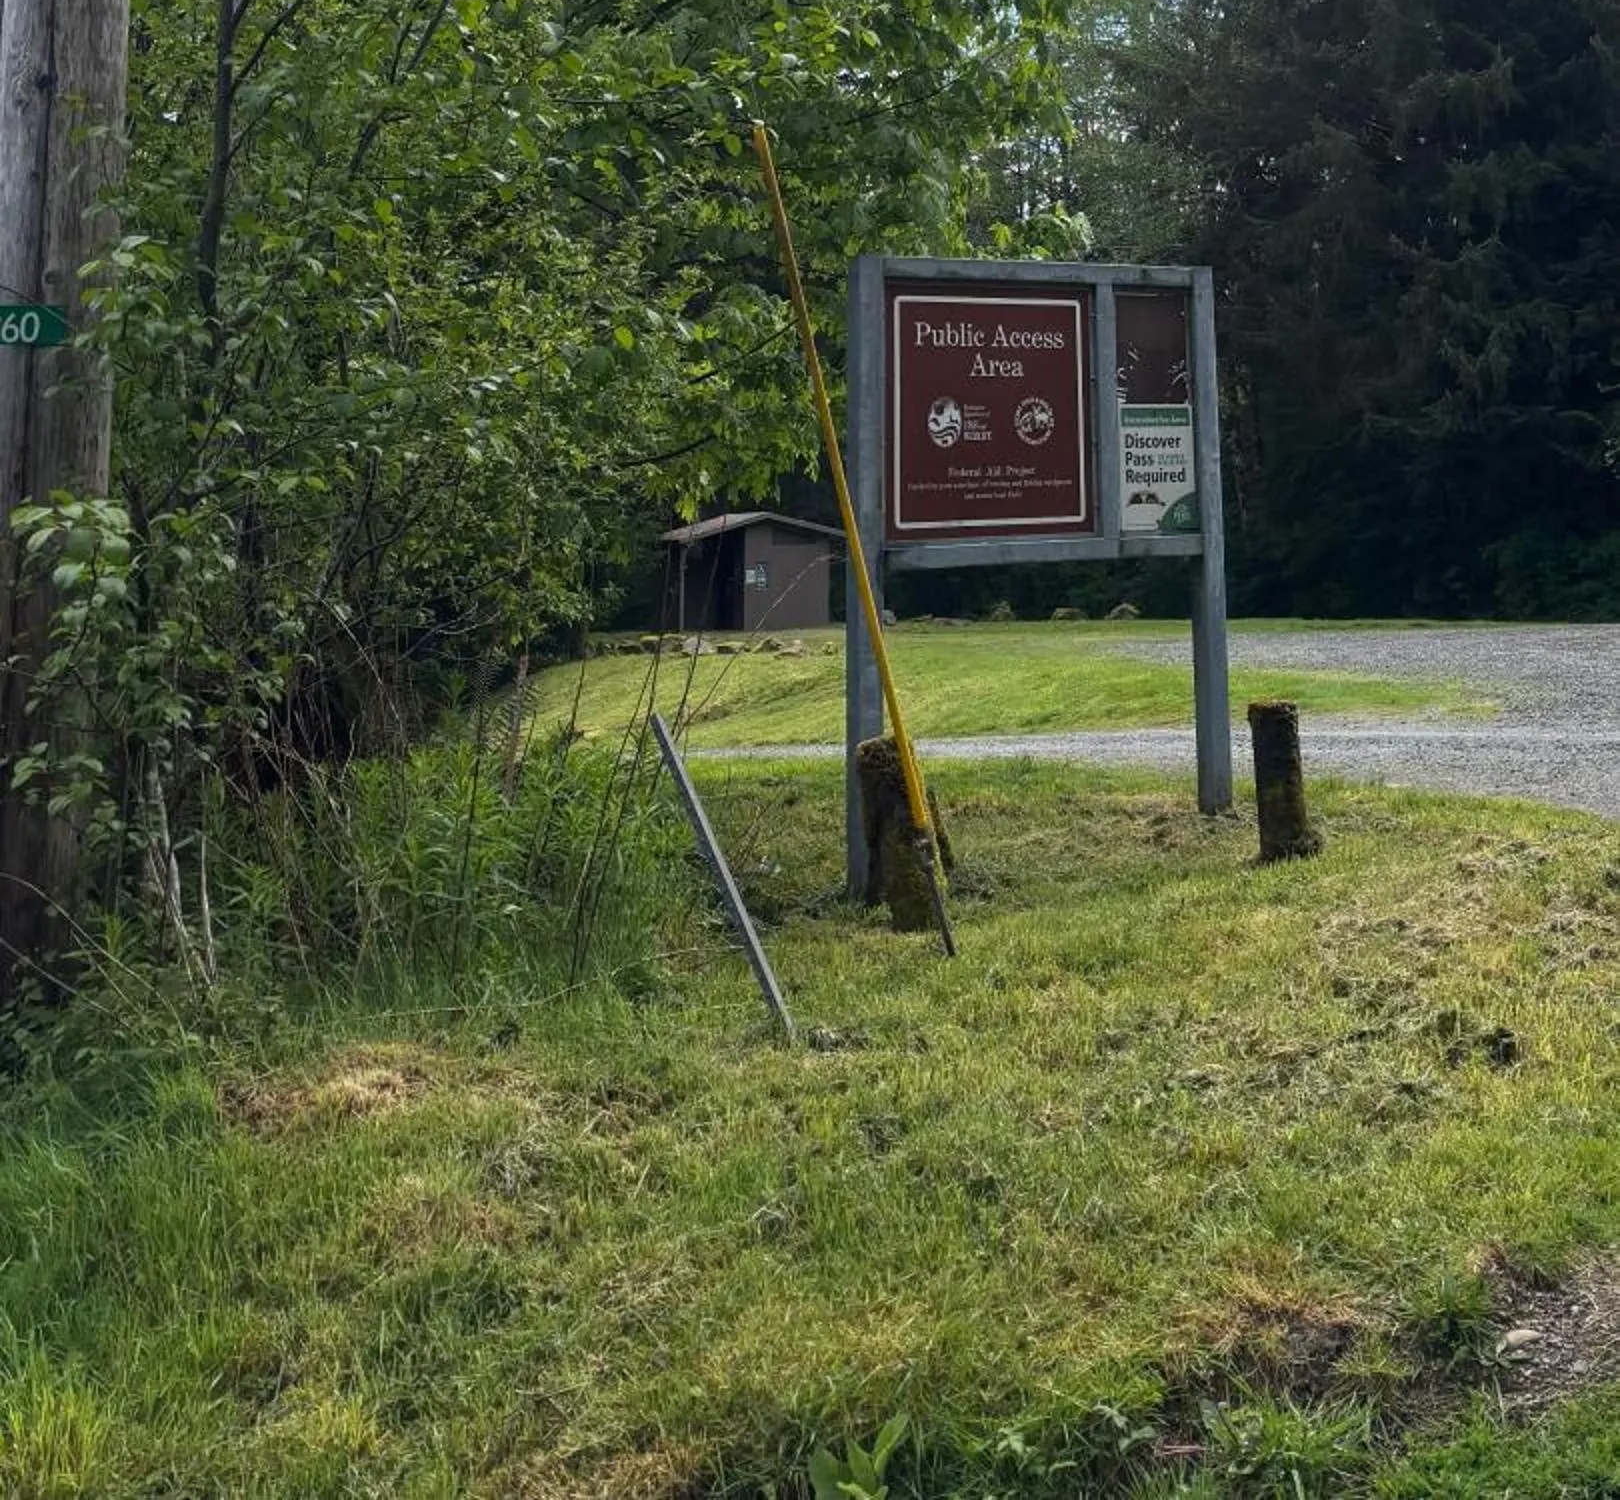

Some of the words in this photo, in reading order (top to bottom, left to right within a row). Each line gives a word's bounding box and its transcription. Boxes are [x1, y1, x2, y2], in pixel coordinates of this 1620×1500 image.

[0, 312, 40, 343] 60
[913, 321, 985, 348] Public
[991, 324, 1065, 349] Access
[969, 353, 1025, 377] Area
[1124, 433, 1181, 449] Discover
[1125, 451, 1154, 466] Pass
[1125, 468, 1187, 487] Required
